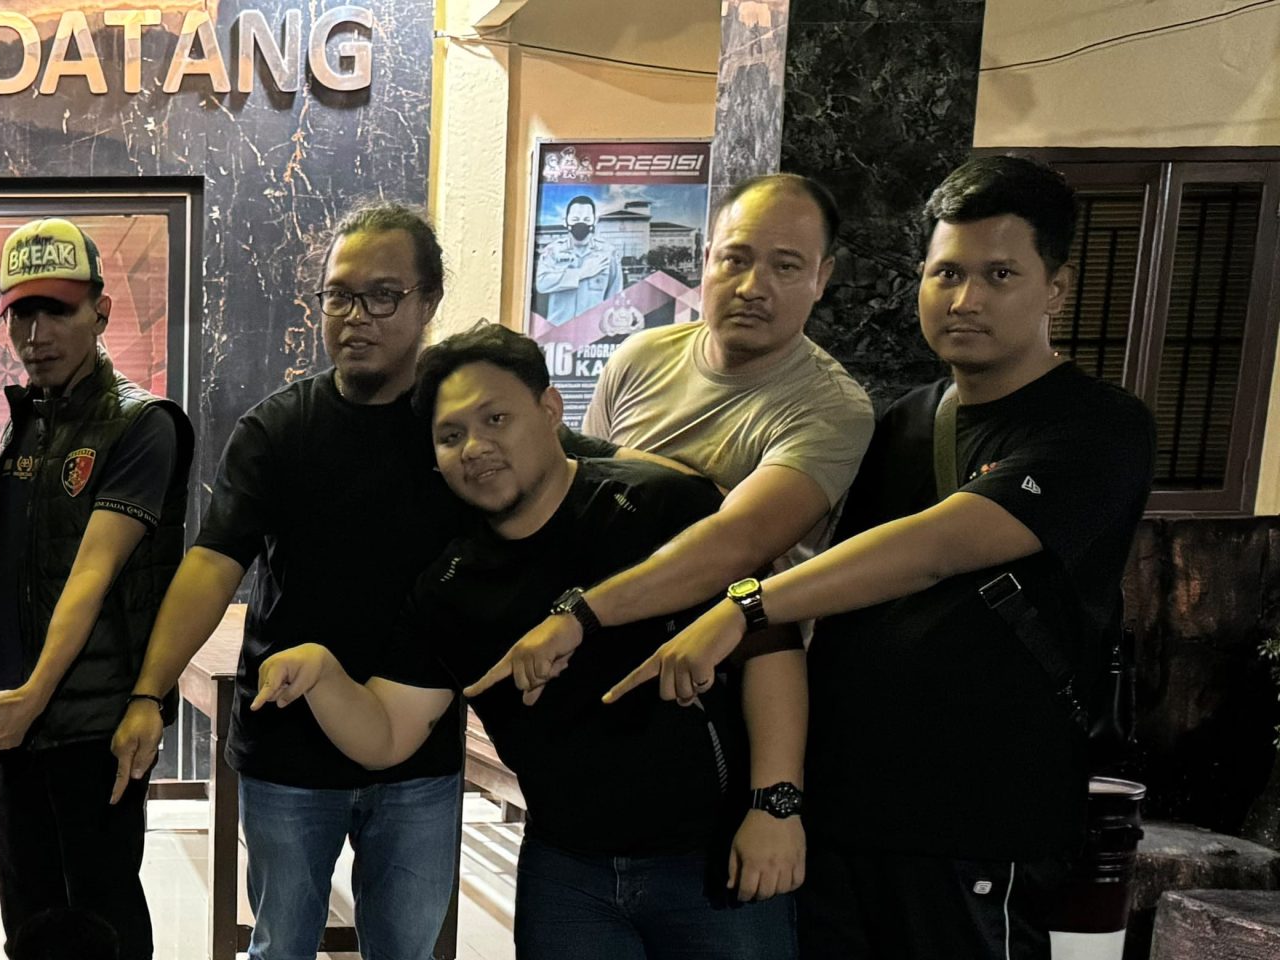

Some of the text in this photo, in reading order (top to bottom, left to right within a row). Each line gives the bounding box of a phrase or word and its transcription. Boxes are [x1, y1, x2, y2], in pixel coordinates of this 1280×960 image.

[596, 154, 705, 170] PRESISI
[9, 244, 76, 270] BREAK
[544, 342, 573, 376] 16
